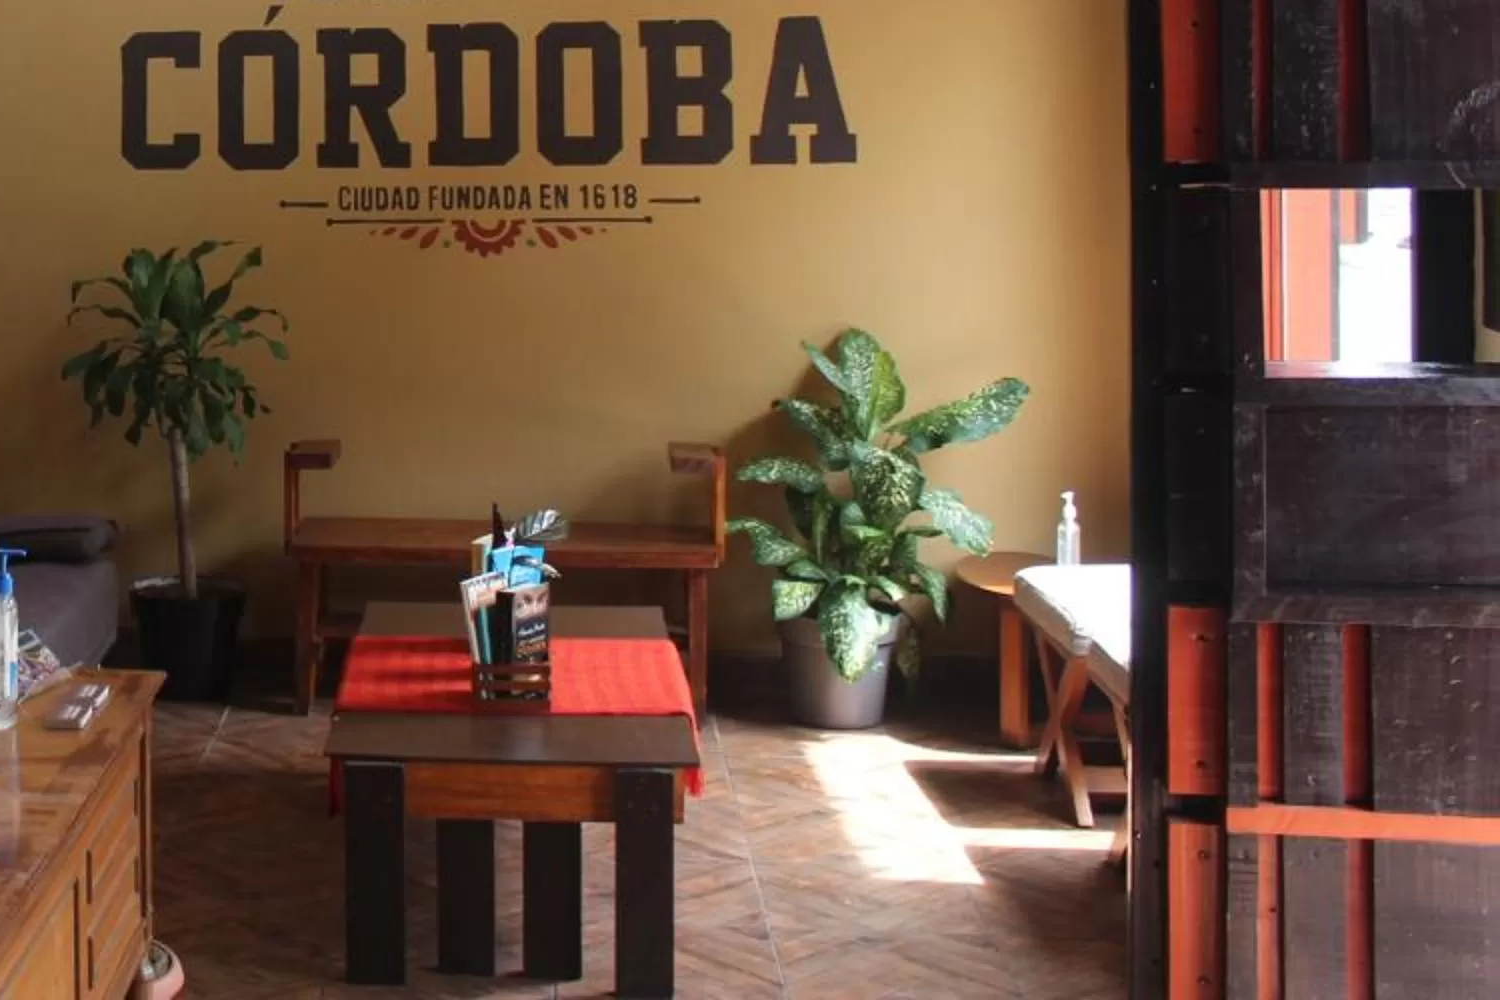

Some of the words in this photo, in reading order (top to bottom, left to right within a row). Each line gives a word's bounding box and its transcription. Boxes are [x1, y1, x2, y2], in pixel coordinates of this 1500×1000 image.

[120, 5, 858, 172] CÓRDOBA
[338, 185, 420, 212] CIUDAD
[428, 184, 532, 211] FUNDADA
[540, 184, 569, 209] EN
[579, 183, 638, 209] 1618
